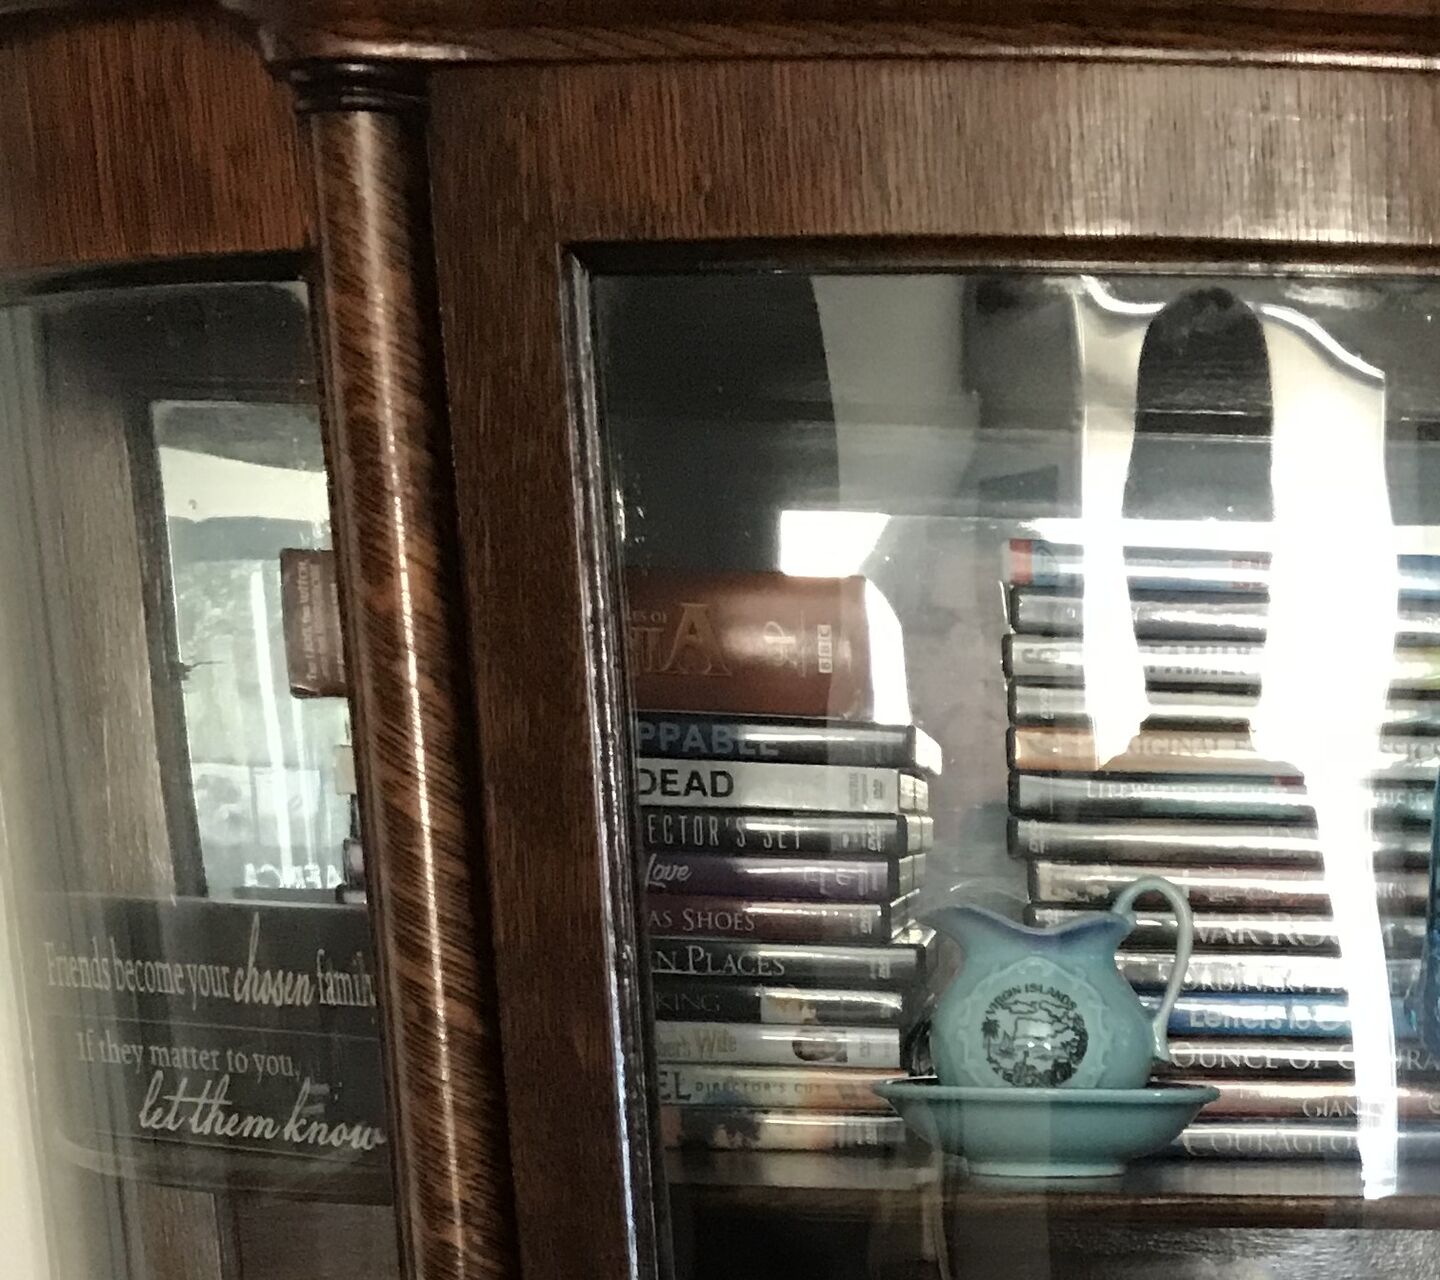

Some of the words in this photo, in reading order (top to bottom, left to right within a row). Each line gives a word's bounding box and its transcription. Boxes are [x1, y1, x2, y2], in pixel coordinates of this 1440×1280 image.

[817, 624, 833, 674] BBC
[638, 768, 735, 798] DEAD
[645, 853, 692, 889] Love
[682, 908, 756, 932] SHOES
[44, 936, 111, 991] Friends
[112, 937, 185, 997] become
[188, 961, 230, 1011] your
[234, 911, 317, 1007] chosen
[686, 944, 786, 976] PLACES
[985, 985, 1021, 1015] VIRGIN
[1024, 983, 1078, 1011] ISLANDS
[77, 1029, 94, 1063] If
[99, 1029, 144, 1074] they
[149, 1045, 220, 1072] matter
[226, 1050, 249, 1074] to
[695, 1080, 787, 1095] DIRECTOR'S
[793, 1083, 822, 1095] CUT
[138, 1070, 187, 1130] let
[188, 1073, 282, 1140] them
[284, 1076, 387, 1151] know
